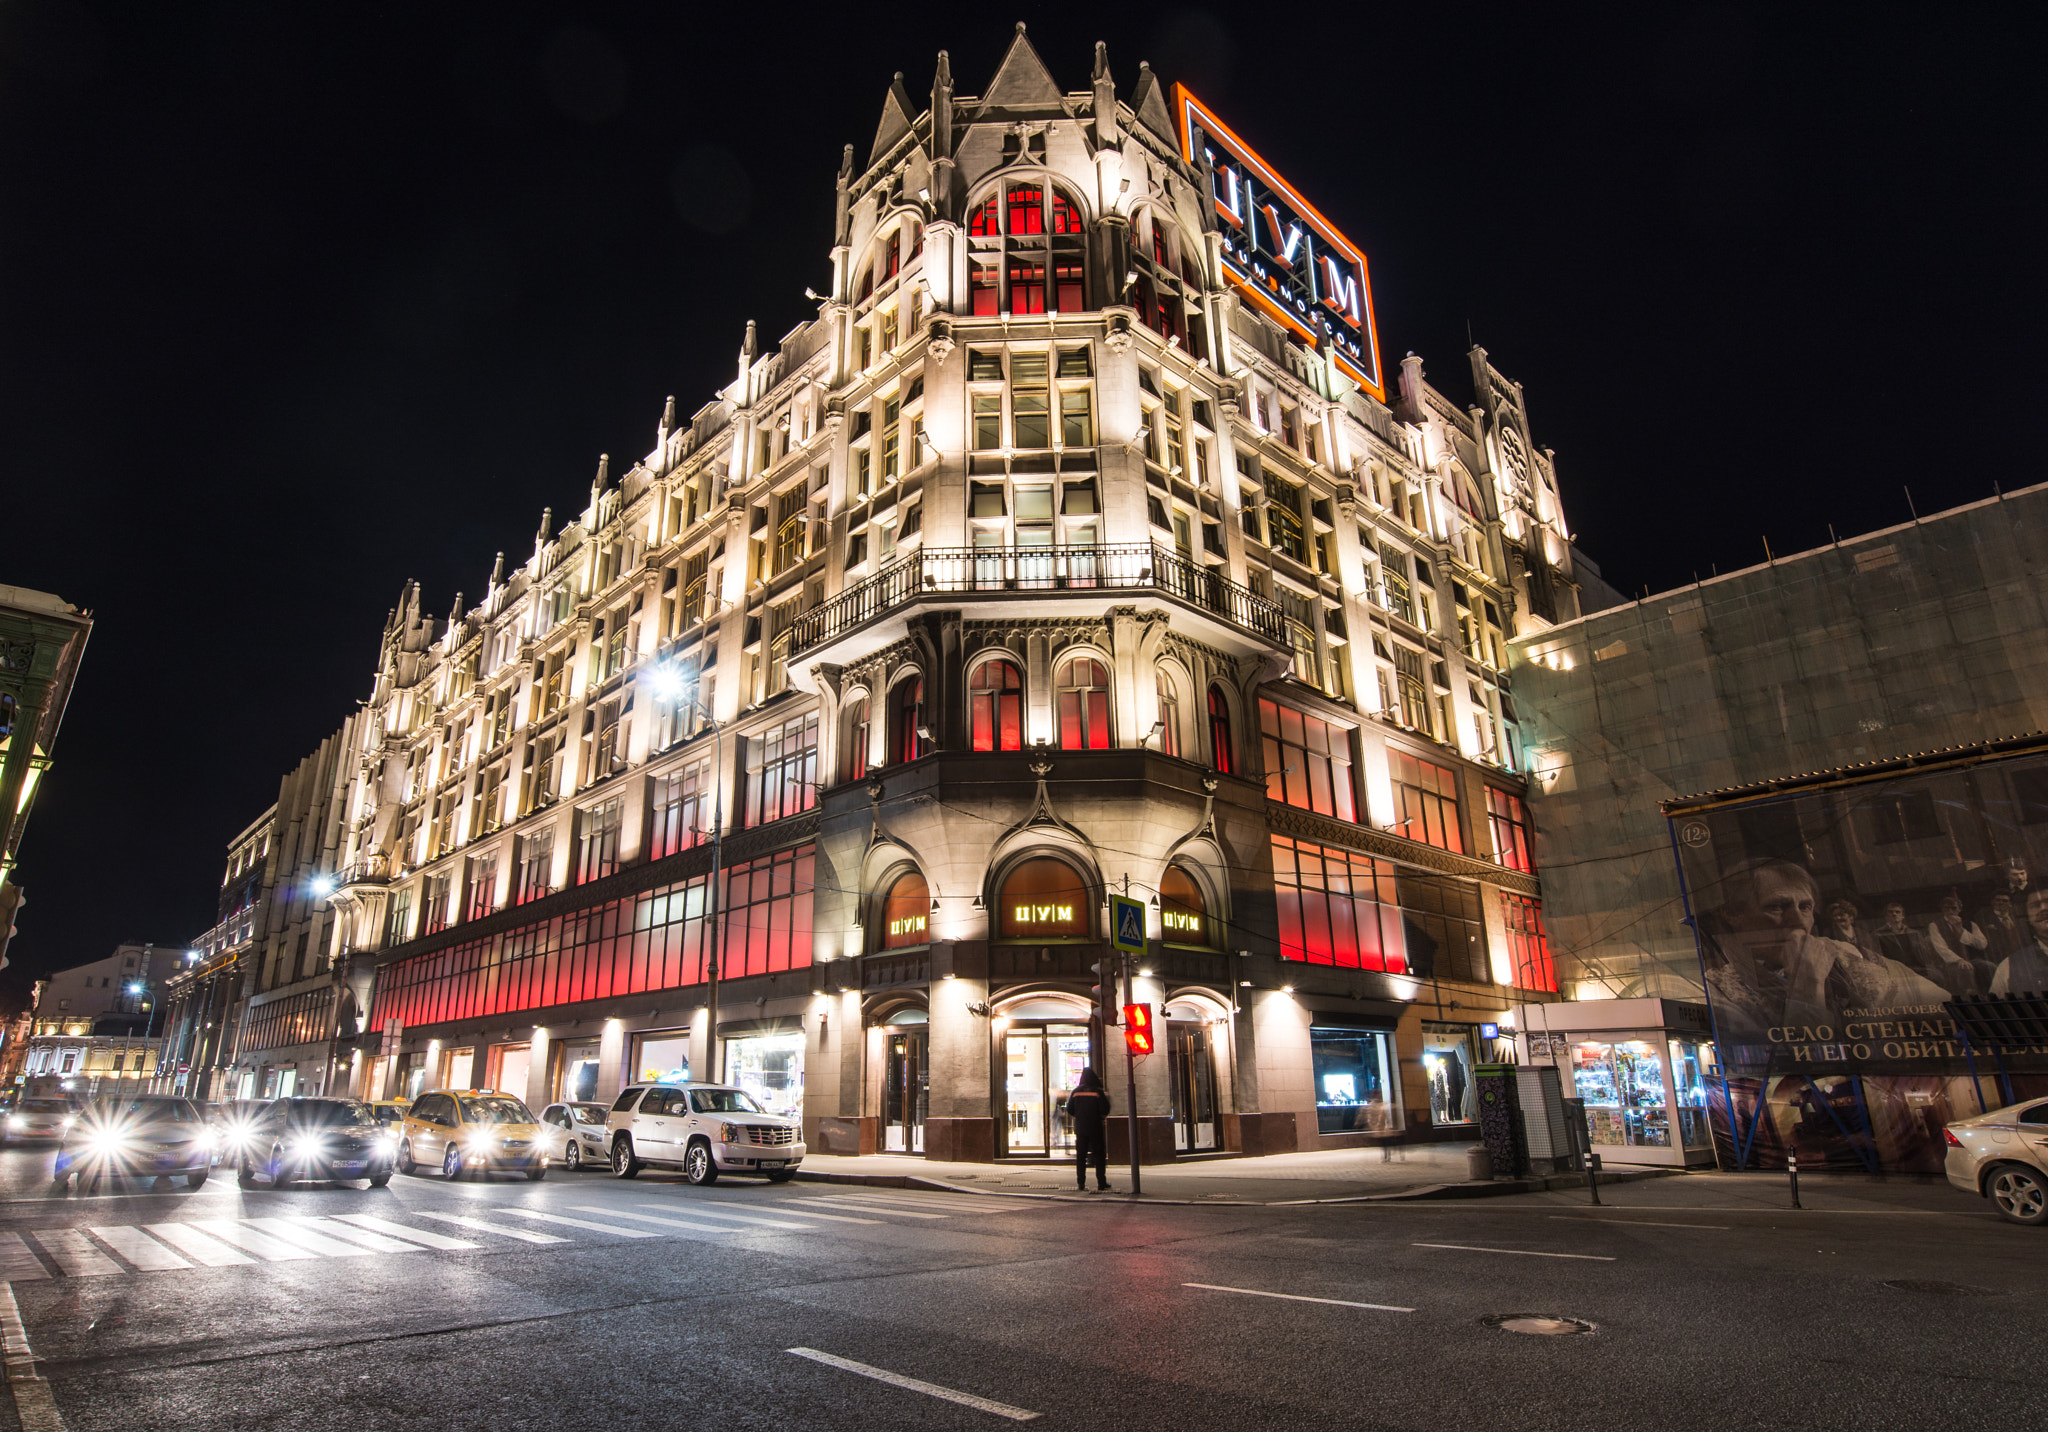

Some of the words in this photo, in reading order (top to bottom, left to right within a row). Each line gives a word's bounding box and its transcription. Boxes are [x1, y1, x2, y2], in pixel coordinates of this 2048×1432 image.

[1280, 285, 1360, 358] MOSCOW
[1685, 826, 1708, 842] 12+
[1485, 1025, 1494, 1037] P
[1767, 1025, 1834, 1043] СЕЛО
[1792, 1046, 1813, 1062] И
[1823, 1043, 1871, 1062] ЕГО
